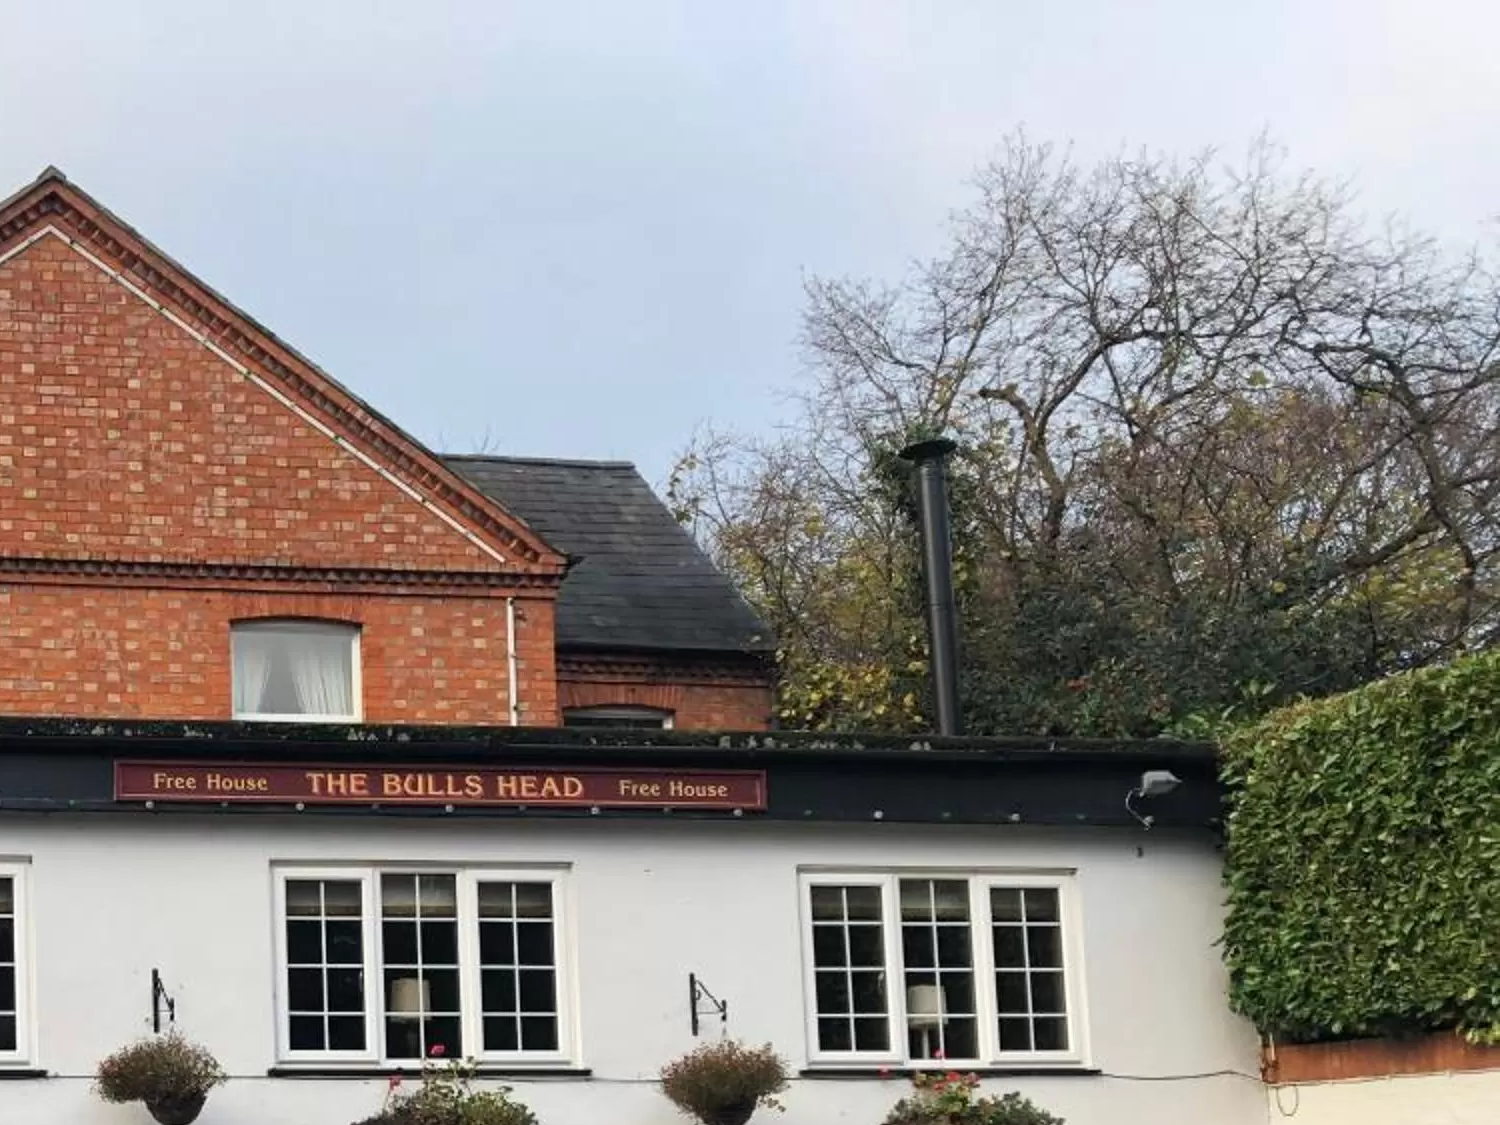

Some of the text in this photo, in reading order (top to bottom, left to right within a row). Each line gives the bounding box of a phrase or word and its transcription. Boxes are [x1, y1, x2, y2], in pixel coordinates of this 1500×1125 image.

[153, 772, 729, 798] Free House THE BULLS HEAD Free House
